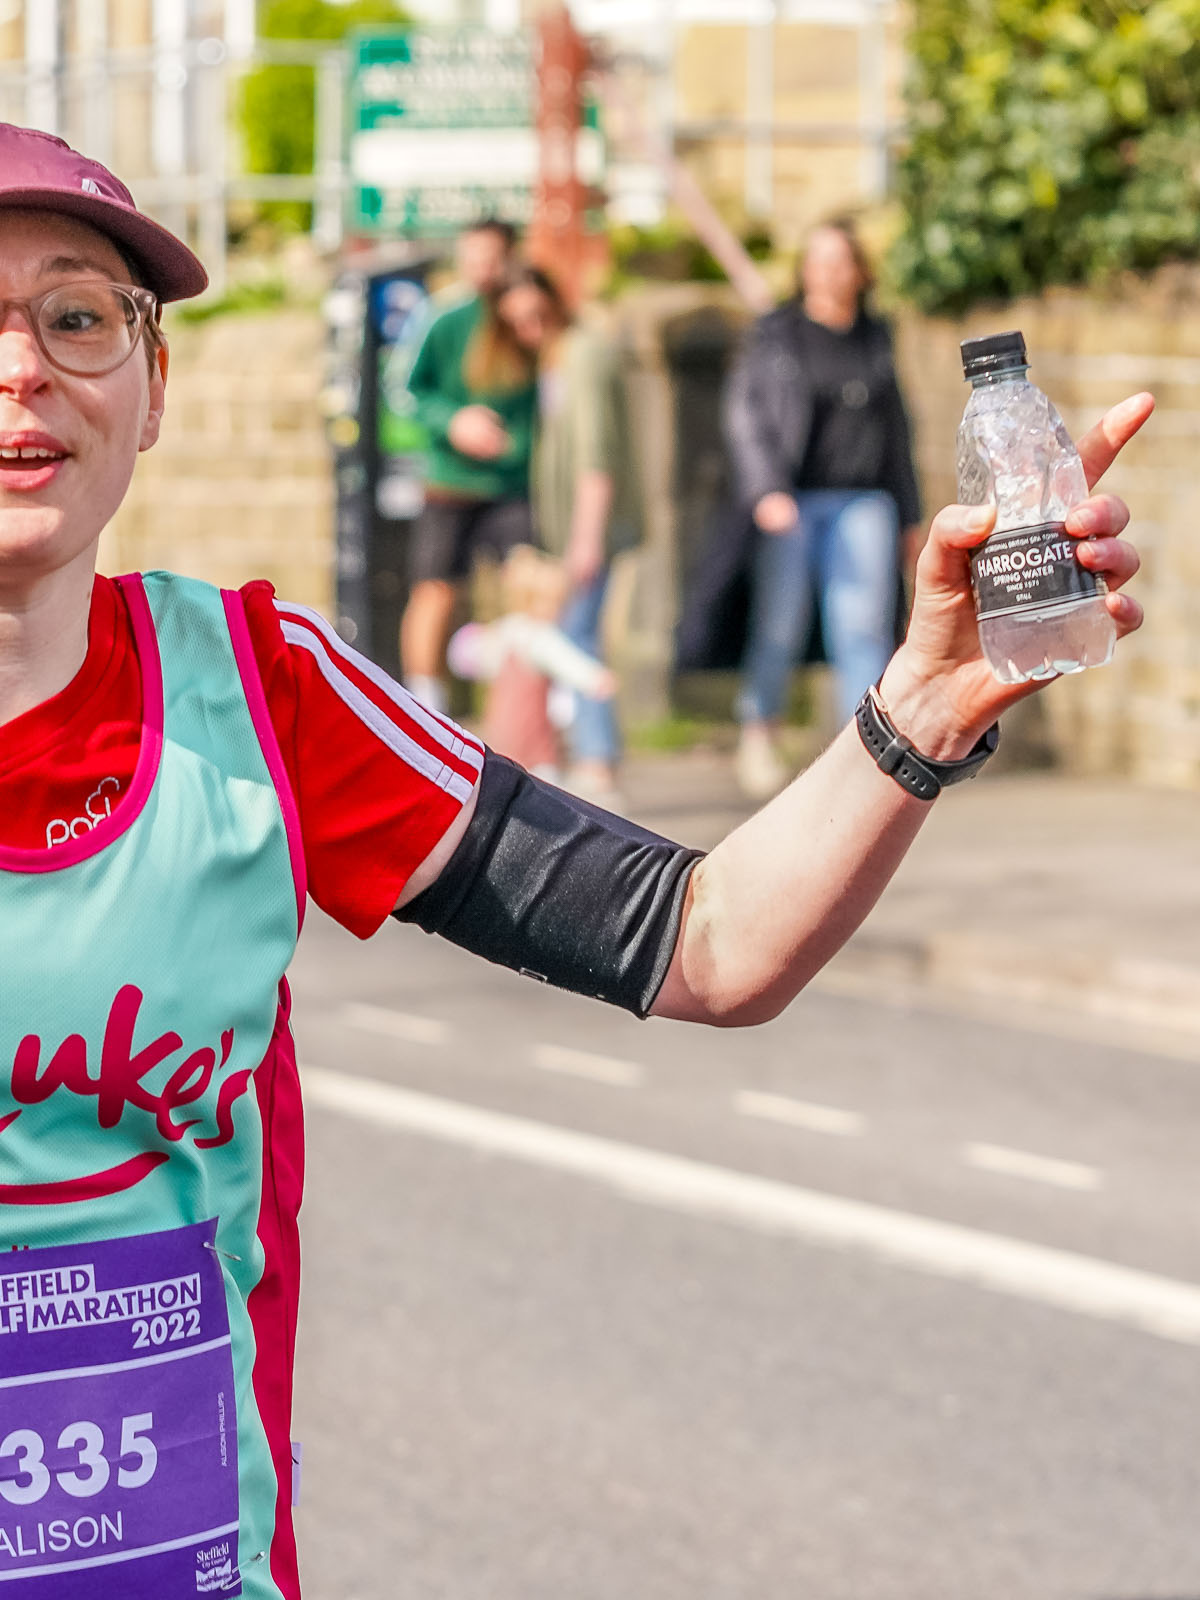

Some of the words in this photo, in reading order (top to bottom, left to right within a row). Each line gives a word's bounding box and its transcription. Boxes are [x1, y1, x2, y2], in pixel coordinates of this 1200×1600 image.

[977, 541, 1074, 578] HARROGATE
[993, 571, 1021, 587] SPRING
[1022, 564, 1055, 580] WATER
[32, 1277, 200, 1329] MARATHON
[131, 1308, 201, 1349] 2022
